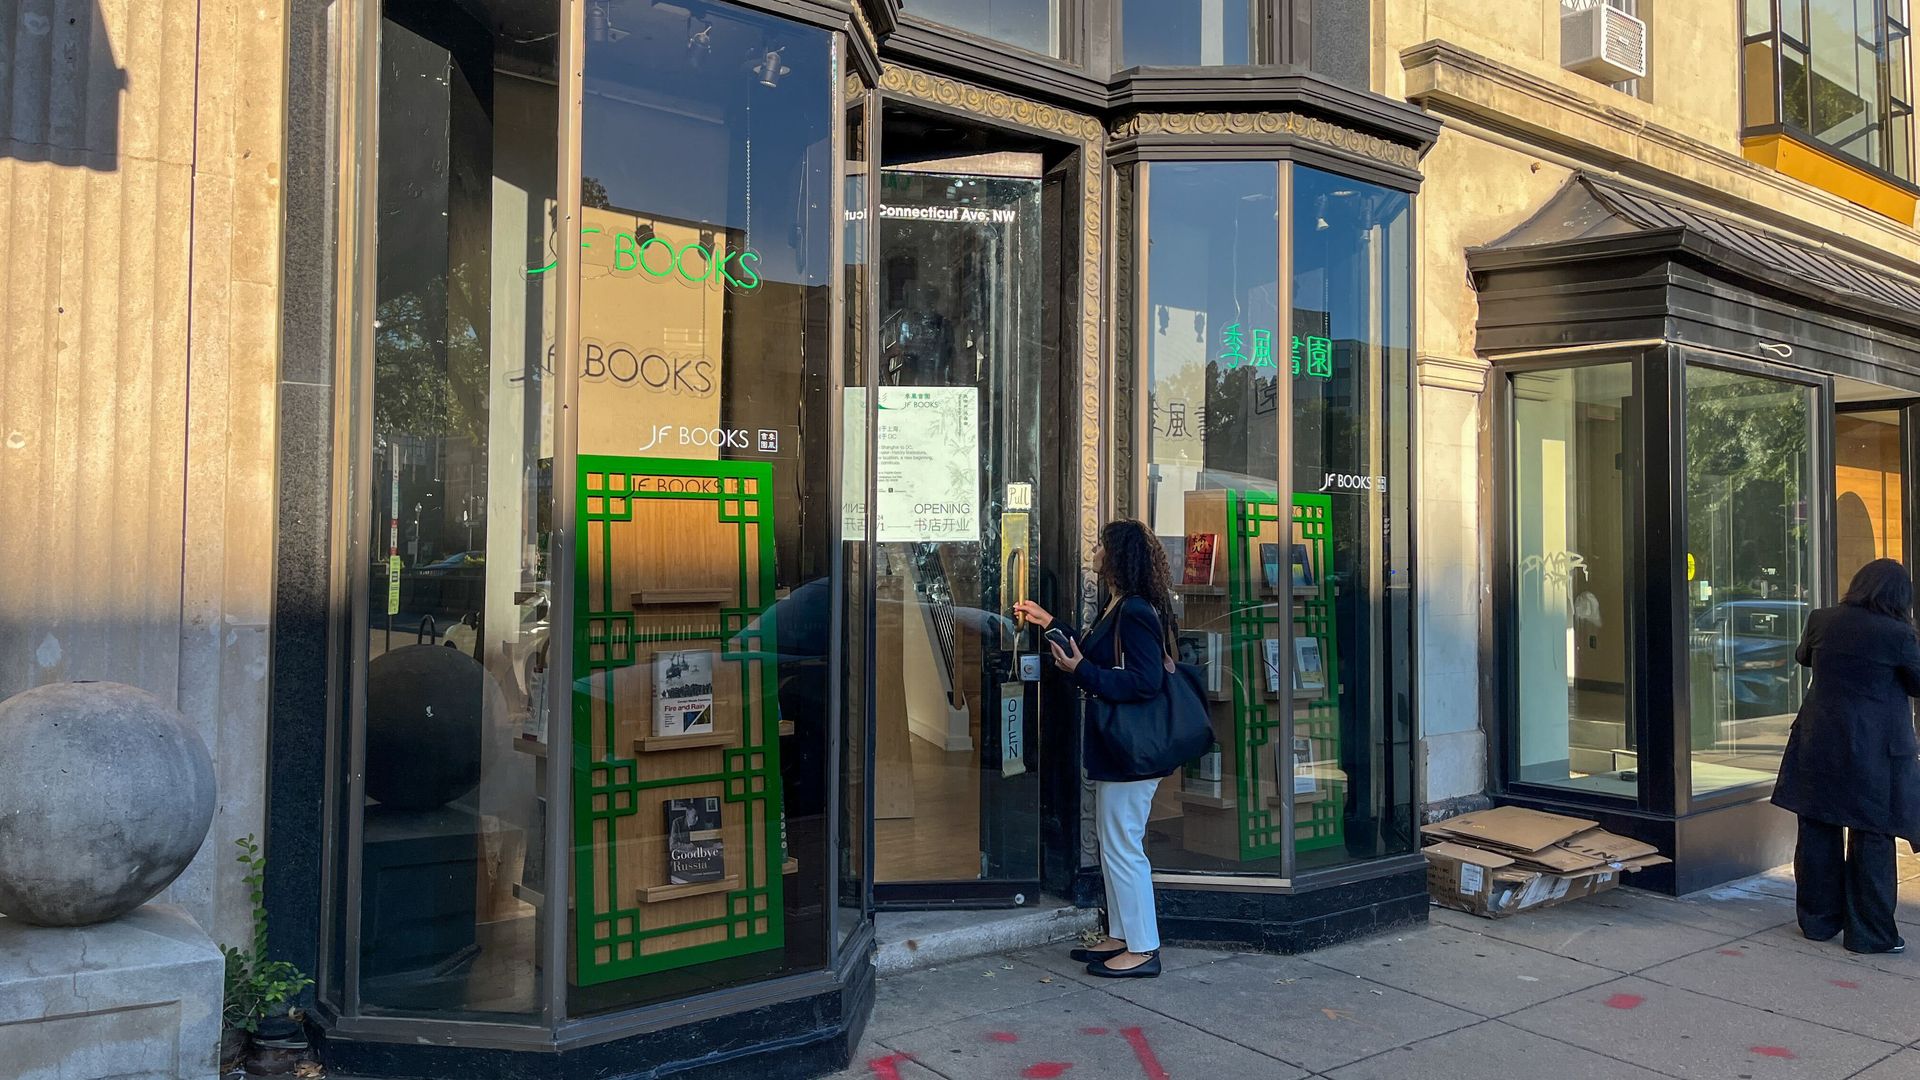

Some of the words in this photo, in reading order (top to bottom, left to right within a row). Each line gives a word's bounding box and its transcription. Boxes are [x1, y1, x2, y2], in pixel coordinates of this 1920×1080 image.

[879, 204, 959, 220] Connecticut
[992, 209, 1015, 222] NW
[614, 232, 760, 289] BOOKS
[913, 401, 939, 409] BOOKS
[639, 425, 672, 451] JF
[679, 427, 749, 450] BOOKS
[657, 478, 725, 494] BOOKS
[1319, 473, 1336, 491] JF
[1338, 475, 1372, 489] BOOKS
[1009, 486, 1029, 506] Pull
[914, 503, 970, 514] OPENING
[914, 518, 970, 532] 书店开业
[1008, 698, 1019, 760] OPEN
[671, 847, 719, 861] Goodbye
[673, 859, 707, 872] Russia
